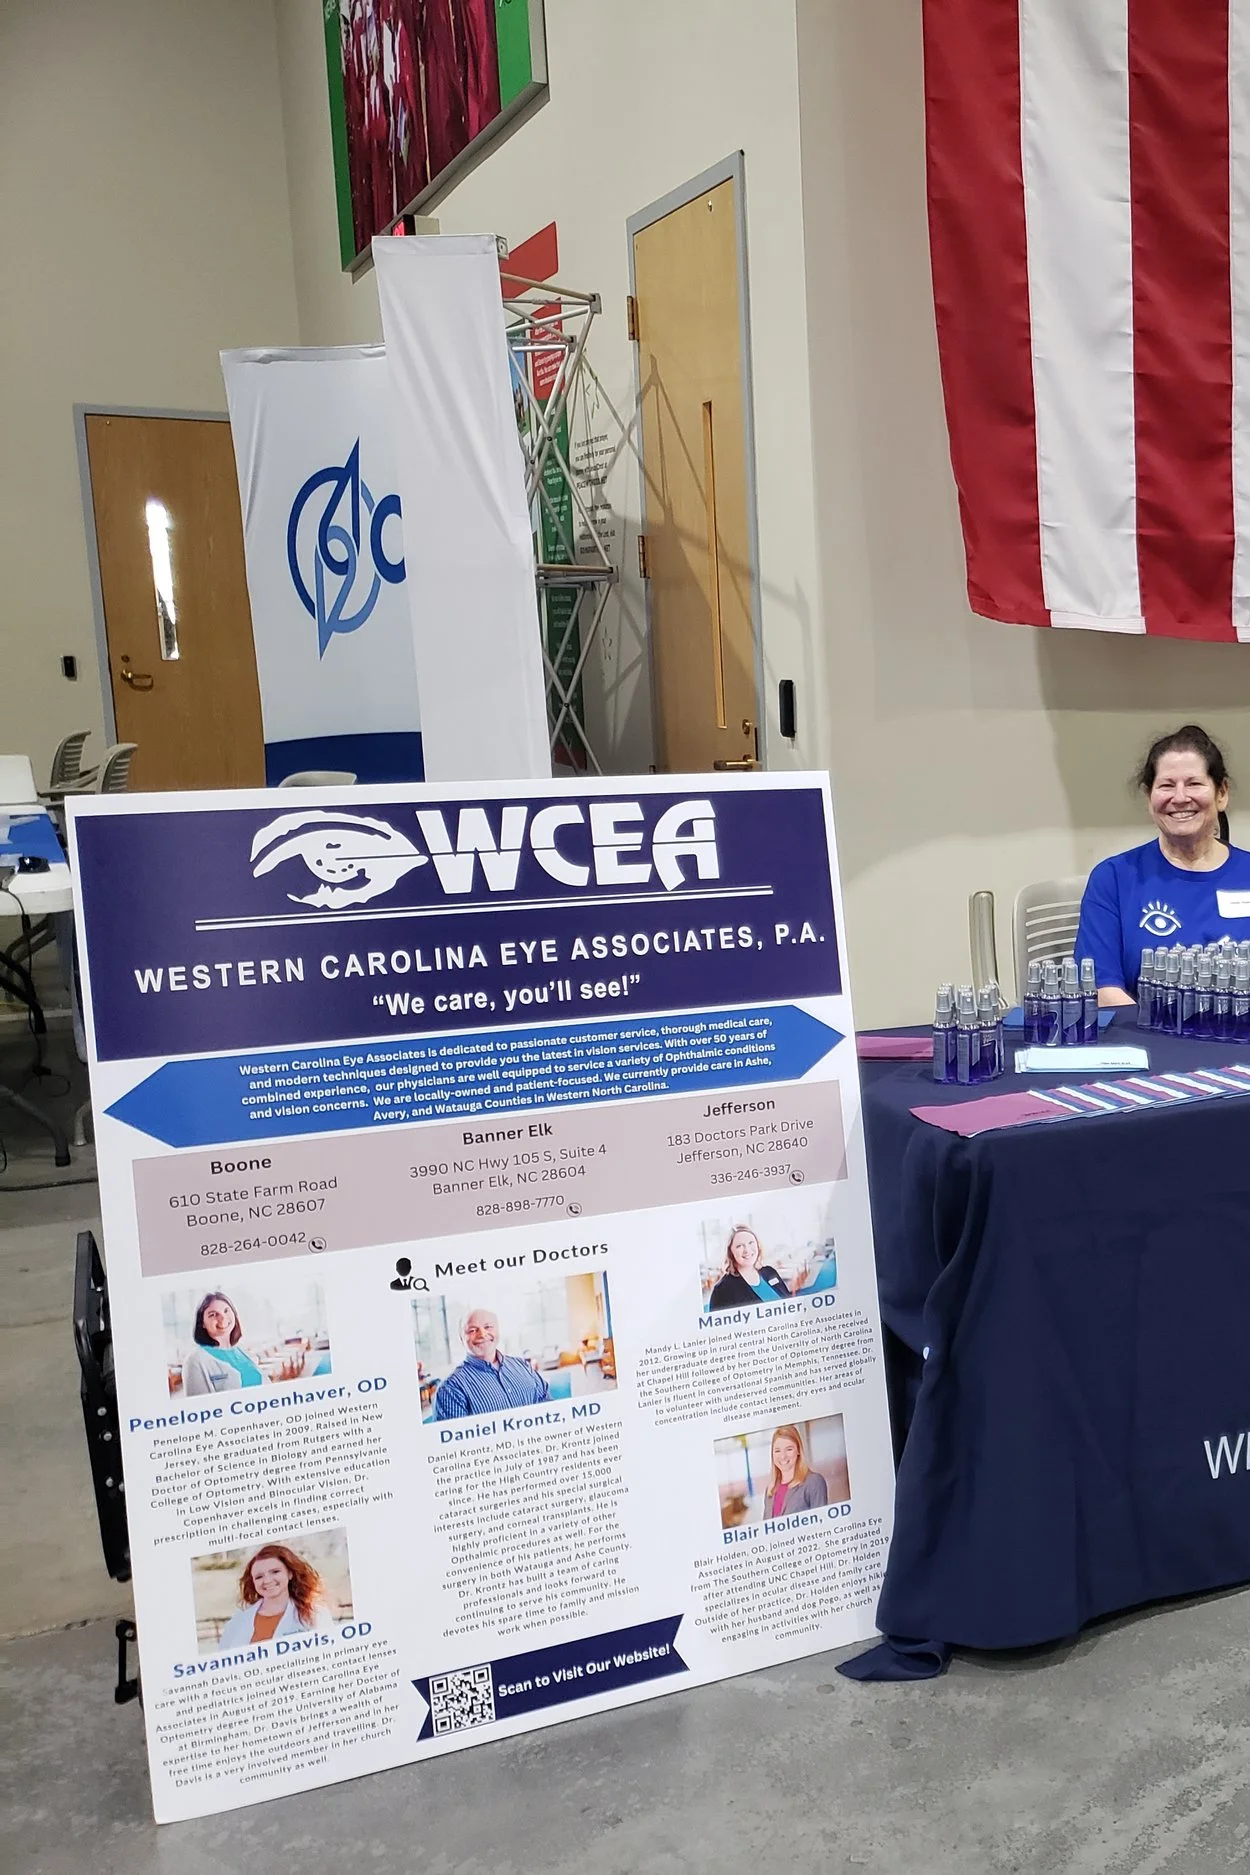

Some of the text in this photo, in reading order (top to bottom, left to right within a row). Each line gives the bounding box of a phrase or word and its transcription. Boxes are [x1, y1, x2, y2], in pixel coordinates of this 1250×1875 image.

[415, 800, 720, 894] WCEA
[134, 921, 824, 993] WESTERN CAROLINA EYE ASSOCIATES, P.A.
[239, 1017, 772, 1075] Western Carolina Eye Associates is dedicated to passionate customer service, thorough medical care,
[249, 1029, 767, 1089] and modern techniques designed to provide you the latest in vision services. With over 50 years of
[241, 1089, 301, 1105] combined
[303, 1085, 370, 1099] experience,
[375, 1082, 395, 1091] our
[397, 1075, 456, 1091] physicians
[457, 1074, 475, 1083] are
[477, 1069, 500, 1080] well
[501, 1064, 552, 1079] equipped
[553, 1064, 566, 1073] to
[567, 1060, 605, 1072] service
[614, 1056, 650, 1066] variety
[652, 1053, 663, 1063] of
[665, 1047, 723, 1063] Ophthalmic
[724, 1043, 776, 1055] conditions
[249, 1056, 771, 1119] and vision concerns. We are locally-owned and patient-focused. We currently provide care in Ashe,
[373, 1081, 669, 1121] Avery, and Watauga Counties in Western North Carolina.
[703, 1100, 775, 1117] Jefferson
[462, 1122, 553, 1145] Banner Elk
[666, 1119, 813, 1147] 183 Doctors Park Drive
[676, 1136, 808, 1164] Jefferson, NC 28640
[210, 1158, 271, 1174] Boone
[410, 1143, 606, 1178] 3990 NC Hwy 105 S, Suite 4
[710, 1163, 791, 1184] 336-246-3937
[169, 1176, 337, 1208] 610 State Farm Road
[432, 1164, 586, 1195] Banner Elk, NC 28604
[186, 1198, 325, 1227] Boone, NC 28607
[476, 1195, 564, 1216] 828-898-7770
[200, 1231, 306, 1256] 828-264-0042
[435, 1243, 608, 1278] Meet our Doctors
[698, 1294, 835, 1329] Mandy Lanier, OD
[129, 1377, 387, 1432] Penelope Copenhaver, OD
[440, 1402, 601, 1443] Daniel Krontz, MD
[723, 1503, 851, 1544] Blair Holden, OD
[173, 1622, 372, 1678] Savannah Davis, OD
[498, 1643, 670, 1697] Scan to Visit Our Website!
